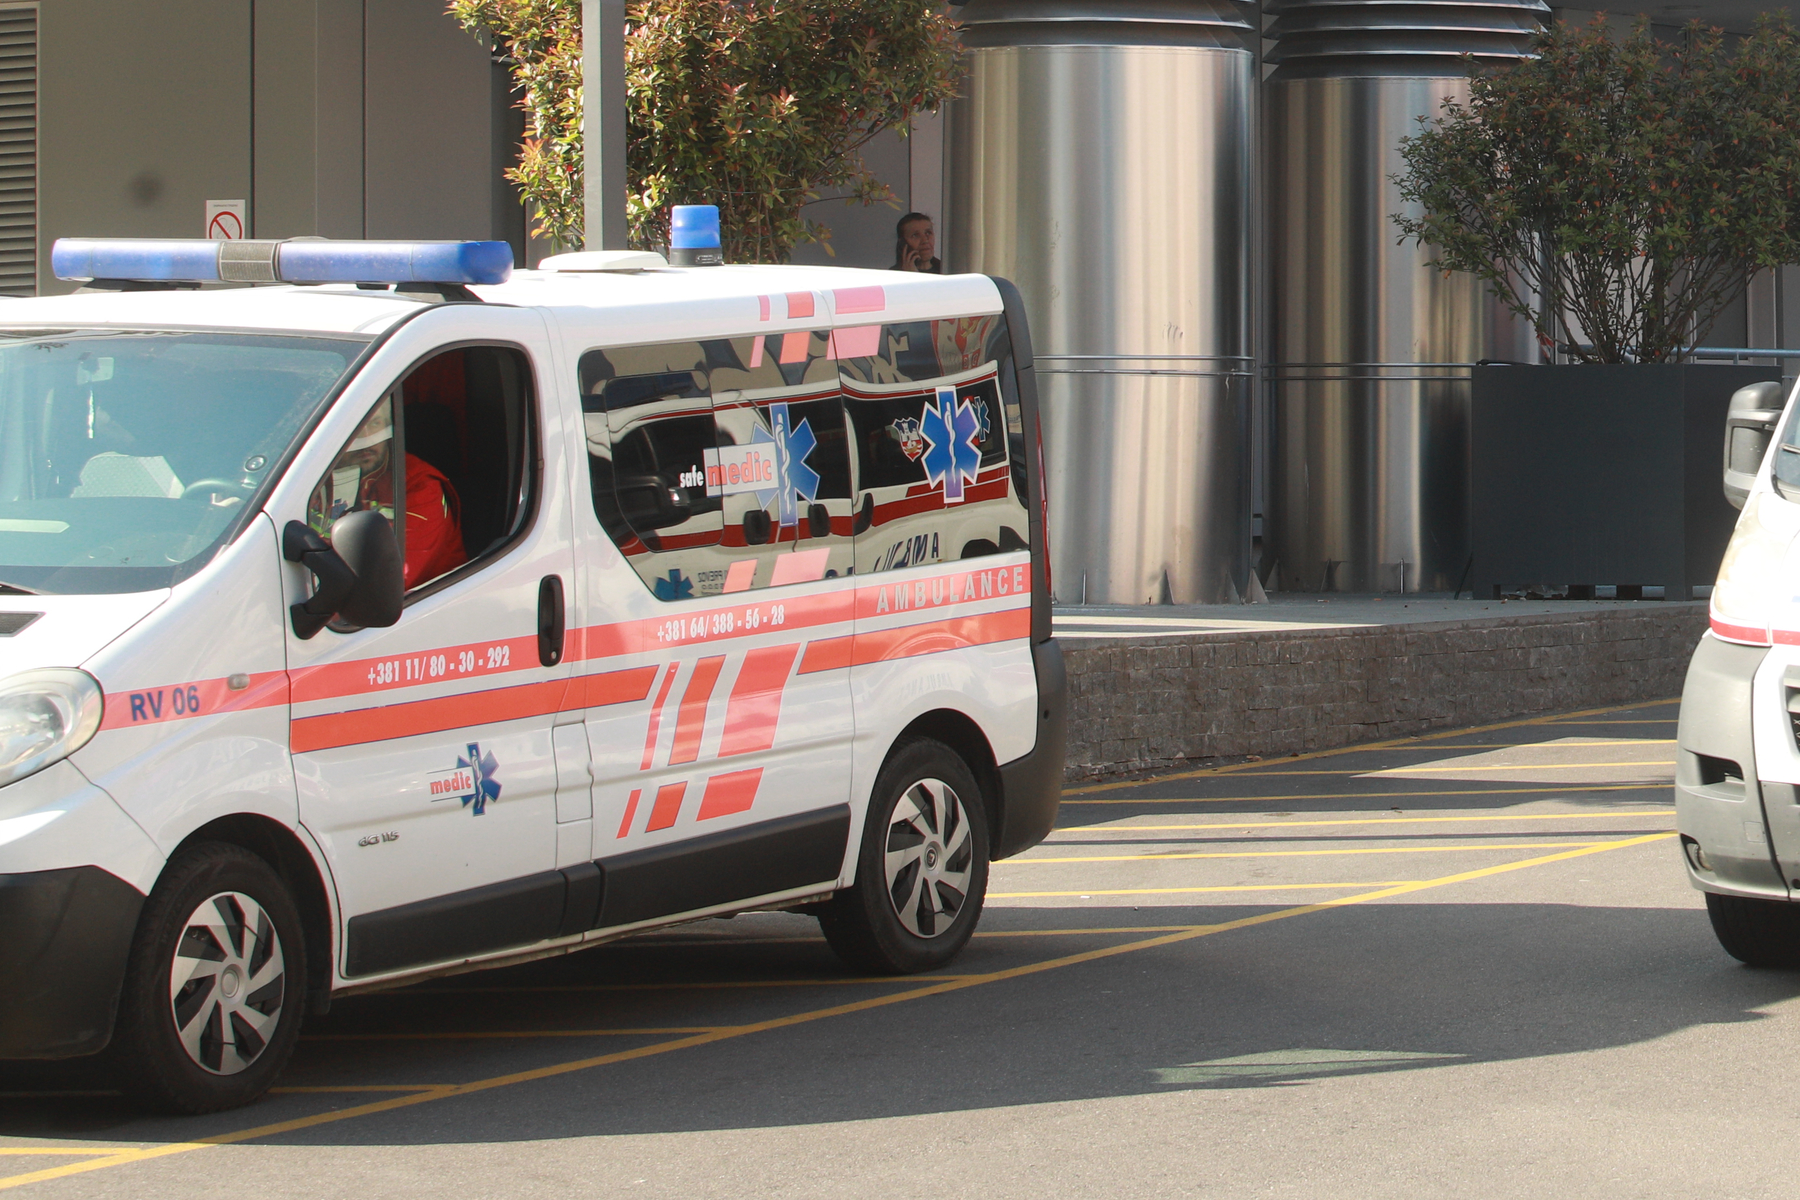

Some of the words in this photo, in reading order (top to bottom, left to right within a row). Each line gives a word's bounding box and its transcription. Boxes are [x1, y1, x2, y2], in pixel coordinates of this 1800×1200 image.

[679, 464, 704, 488] safe
[707, 451, 772, 487] medic
[876, 566, 1023, 613] AMBULANCE
[657, 619, 686, 642] +381
[712, 612, 734, 635] 388
[745, 608, 760, 629] 56
[771, 604, 785, 625] 28
[368, 660, 400, 685] +381
[430, 654, 446, 677] 80
[459, 650, 475, 673] 30
[487, 645, 510, 669] 292
[130, 690, 164, 721] RV
[173, 685, 199, 715] 06
[430, 771, 472, 795] medic
